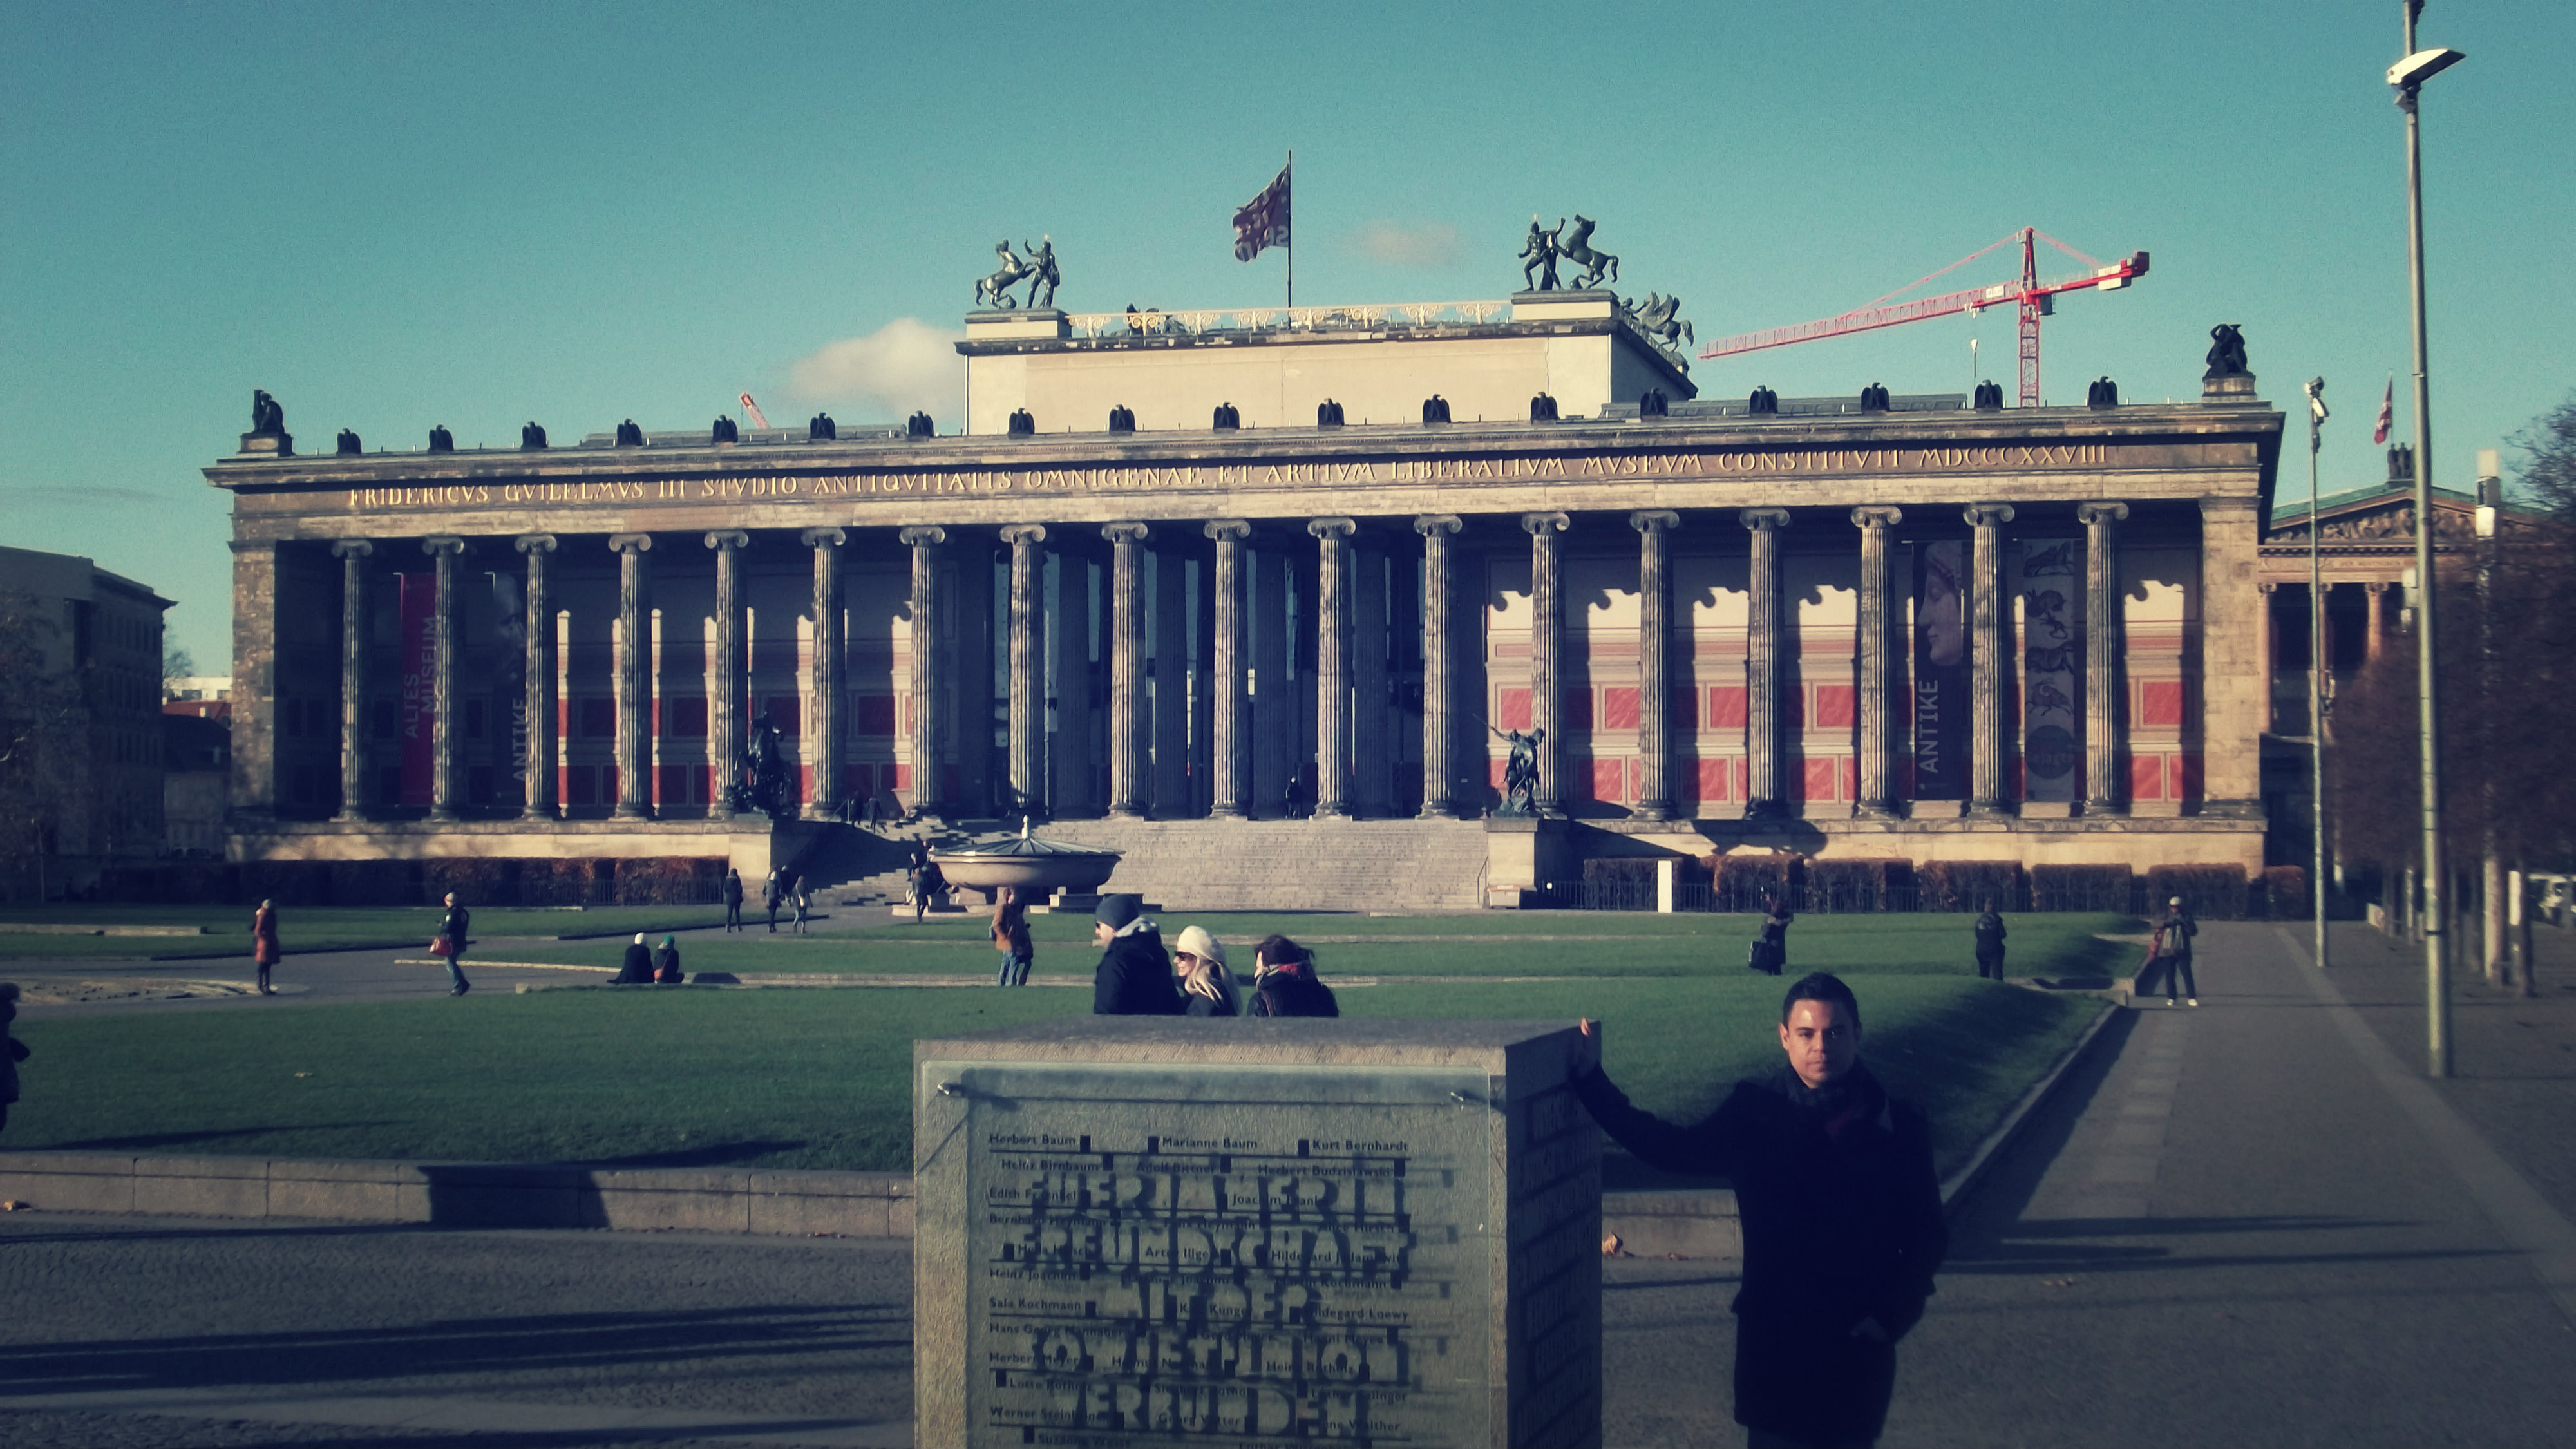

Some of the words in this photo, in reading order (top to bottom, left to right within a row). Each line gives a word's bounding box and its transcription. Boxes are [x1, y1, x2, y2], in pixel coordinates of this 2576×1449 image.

[348, 486, 489, 507] FRIDERICVS
[504, 480, 644, 502] GVILELMVS
[659, 479, 686, 498] III
[701, 475, 798, 498] STVDIO
[813, 469, 1013, 496] ANTIQVITATIS
[1026, 465, 1204, 489] OMNIGENAE
[1218, 464, 1254, 485] ET
[1264, 462, 1378, 484] ARTIVM
[1391, 456, 1567, 480] LIBERALIVM
[1582, 453, 1704, 477] MVSEVM
[1718, 448, 1906, 472] CONSTITVIT
[1918, 444, 2108, 468] MDCCCXXVIII
[421, 616, 436, 714] MUSEUM
[404, 674, 419, 739] ALTES
[1918, 680, 1938, 773] ANTIKE
[512, 697, 526, 782] ANTIKE
[990, 1133, 1037, 1145] Herbert
[1041, 1134, 1077, 1146] Baum
[1162, 1136, 1218, 1149] Marianne
[1223, 1137, 1258, 1150] Baum
[1312, 1139, 1340, 1151] Kurt
